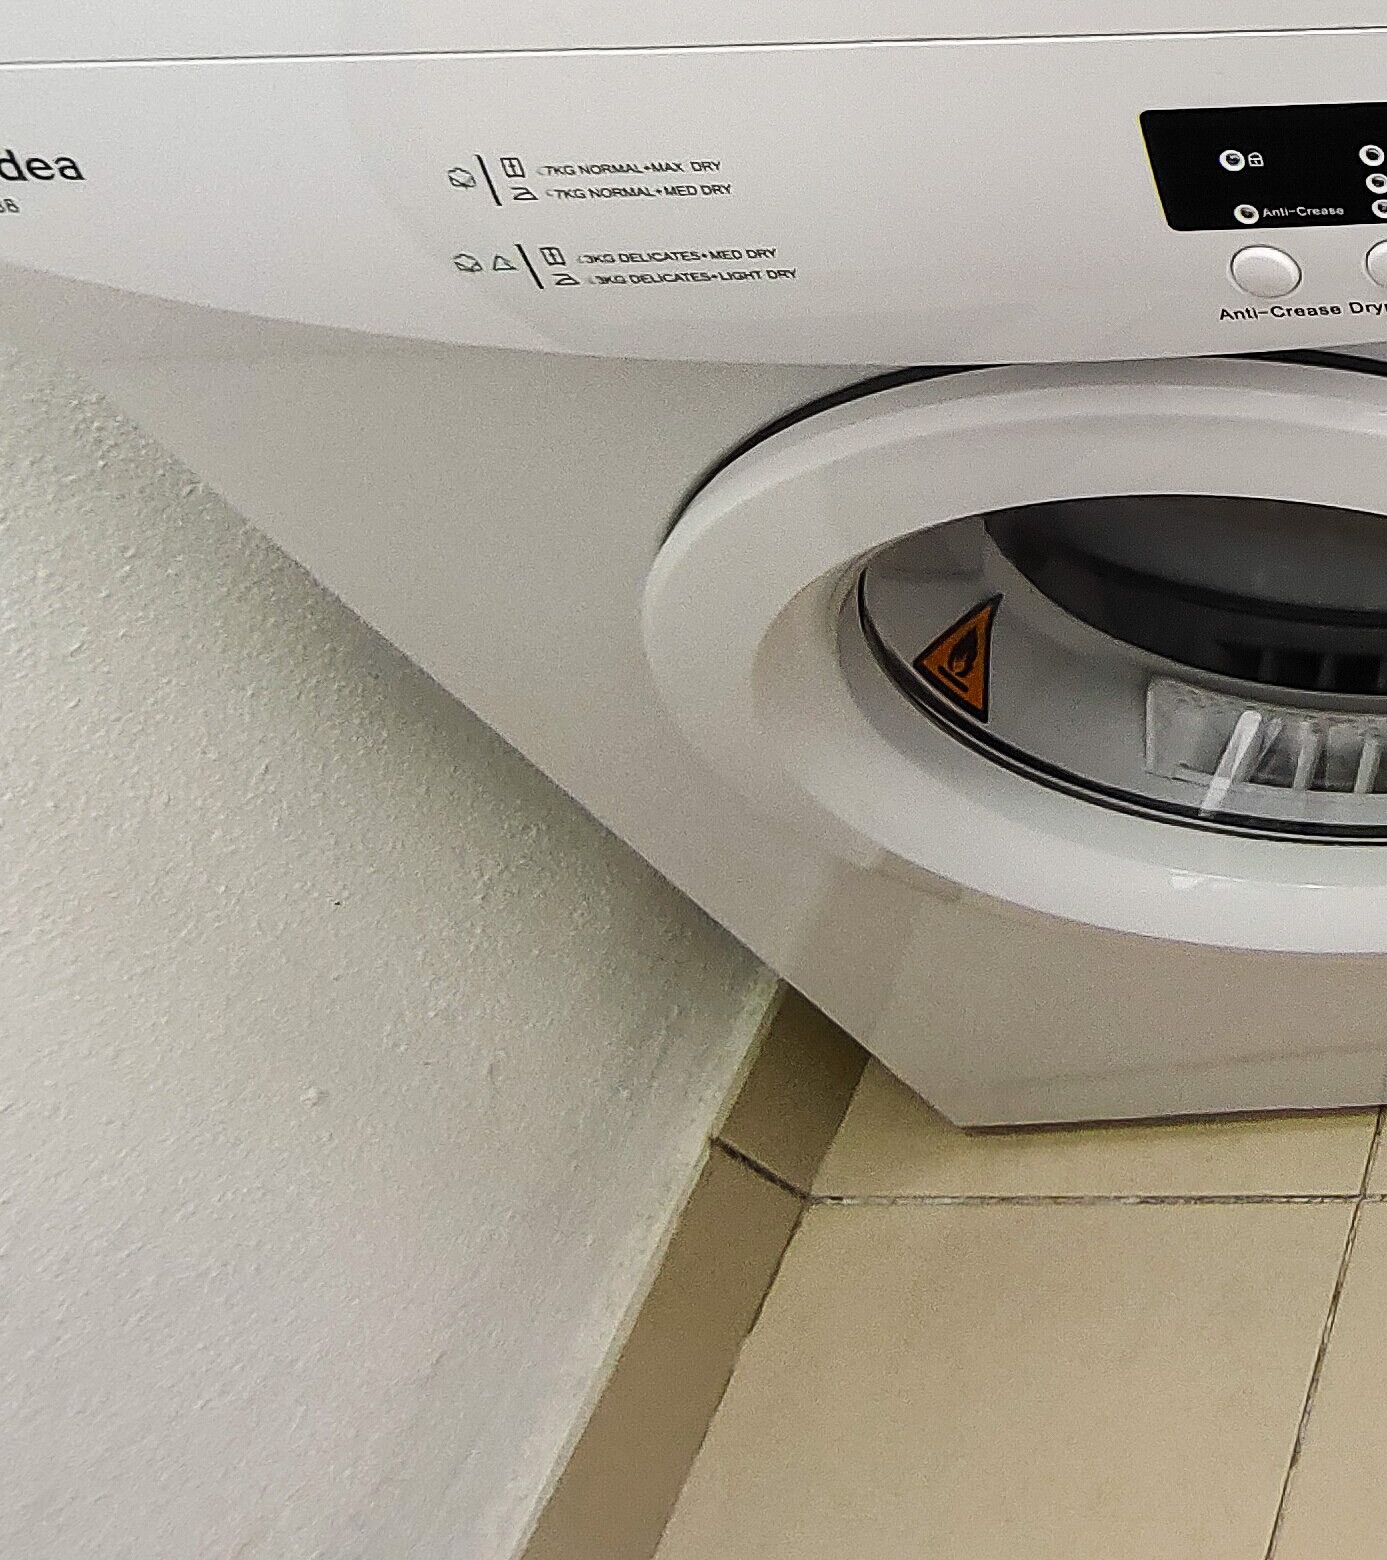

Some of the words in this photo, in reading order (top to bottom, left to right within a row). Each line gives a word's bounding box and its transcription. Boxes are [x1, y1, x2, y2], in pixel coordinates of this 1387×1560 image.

[690, 160, 721, 172] DRY
[700, 183, 732, 196] DRY
[1262, 205, 1345, 218] Anti-Crease
[746, 248, 777, 259] DRY
[766, 268, 797, 280] DRY
[1219, 302, 1342, 322] Anti-Crease
